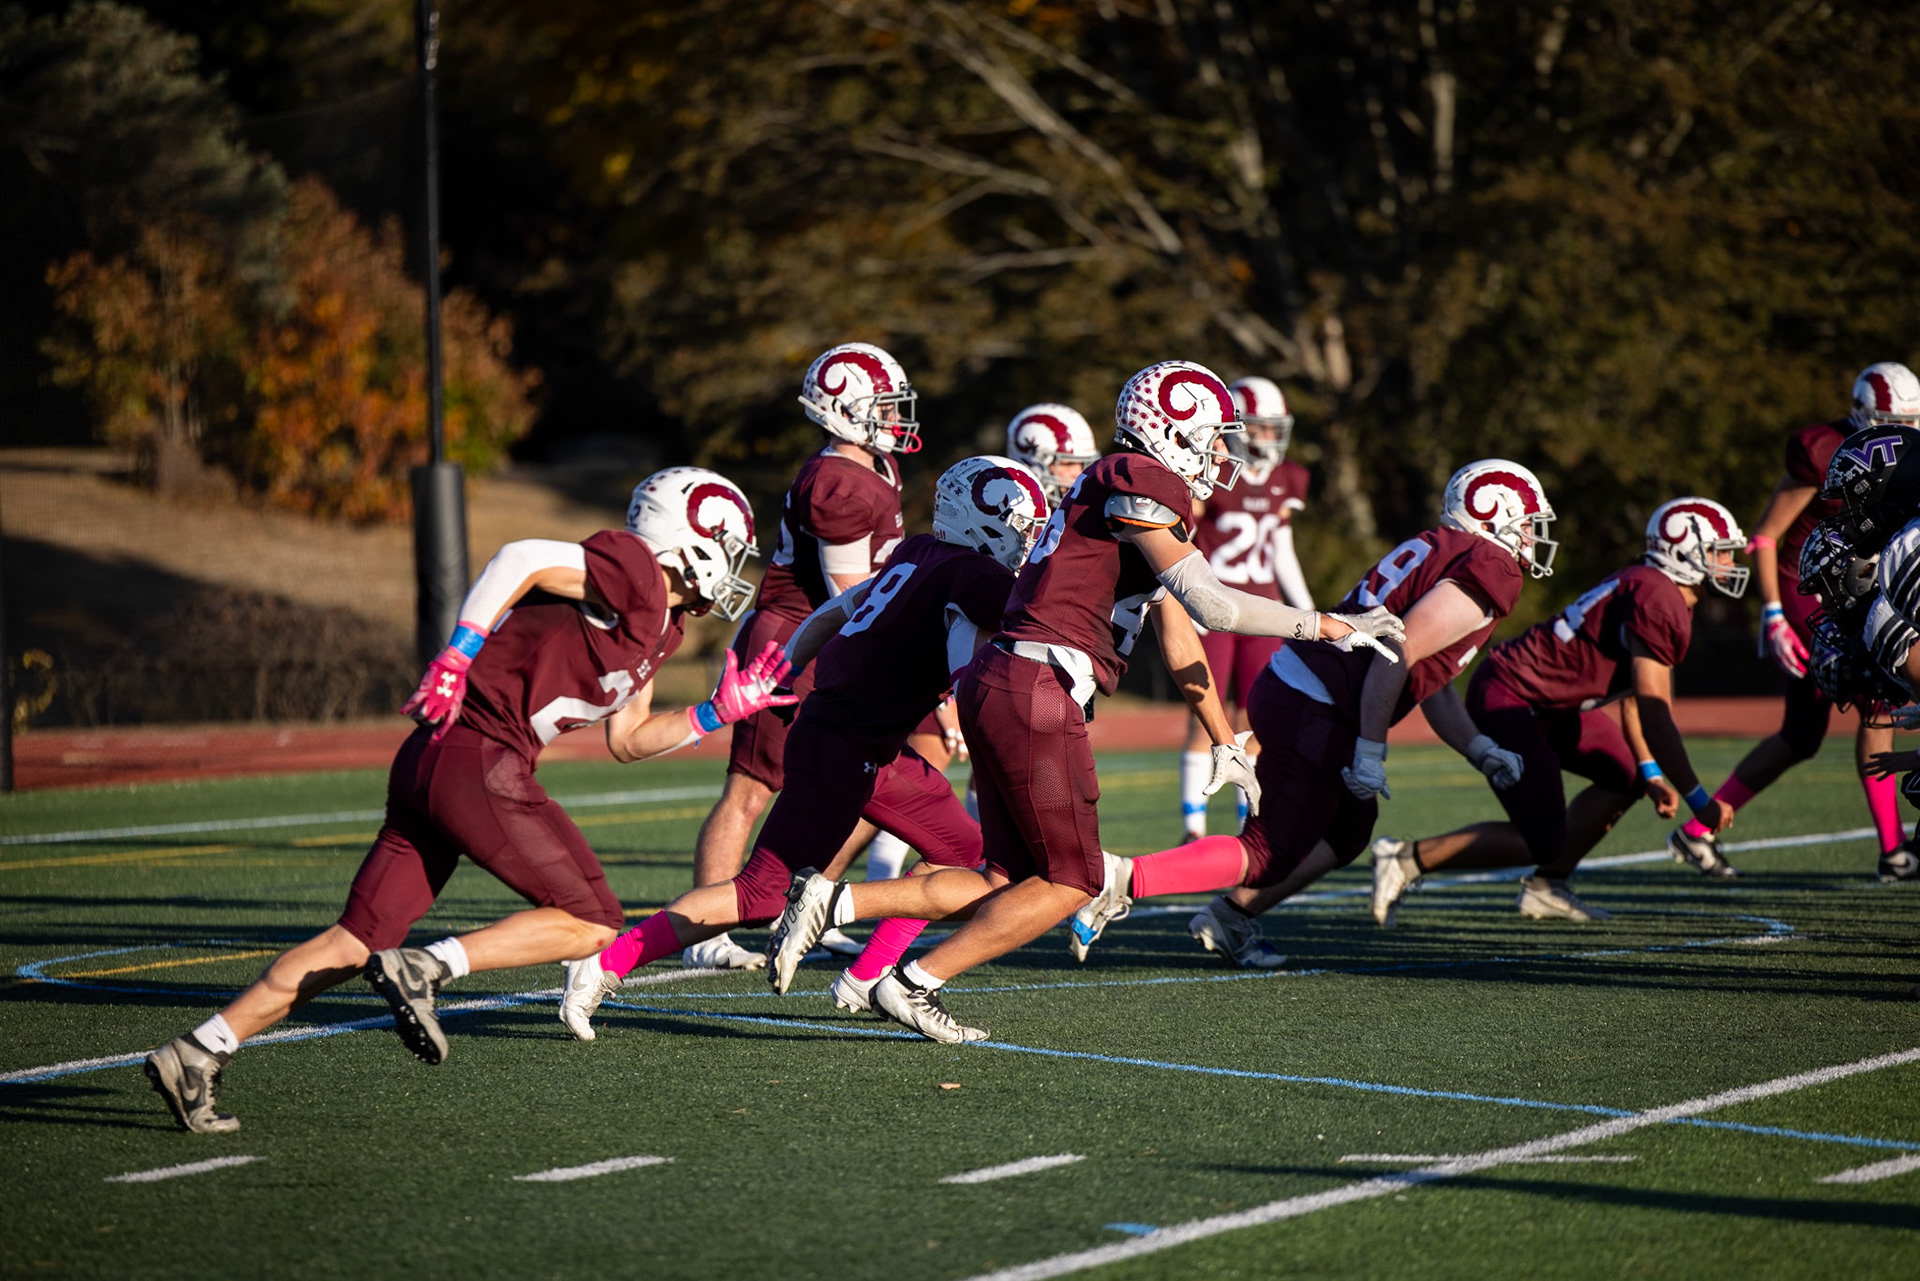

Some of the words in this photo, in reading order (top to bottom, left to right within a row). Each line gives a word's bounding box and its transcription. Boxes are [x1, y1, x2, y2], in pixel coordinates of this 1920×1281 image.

[1844, 434, 1903, 472] VT
[838, 561, 918, 638] 8
[1343, 537, 1433, 608] 9
